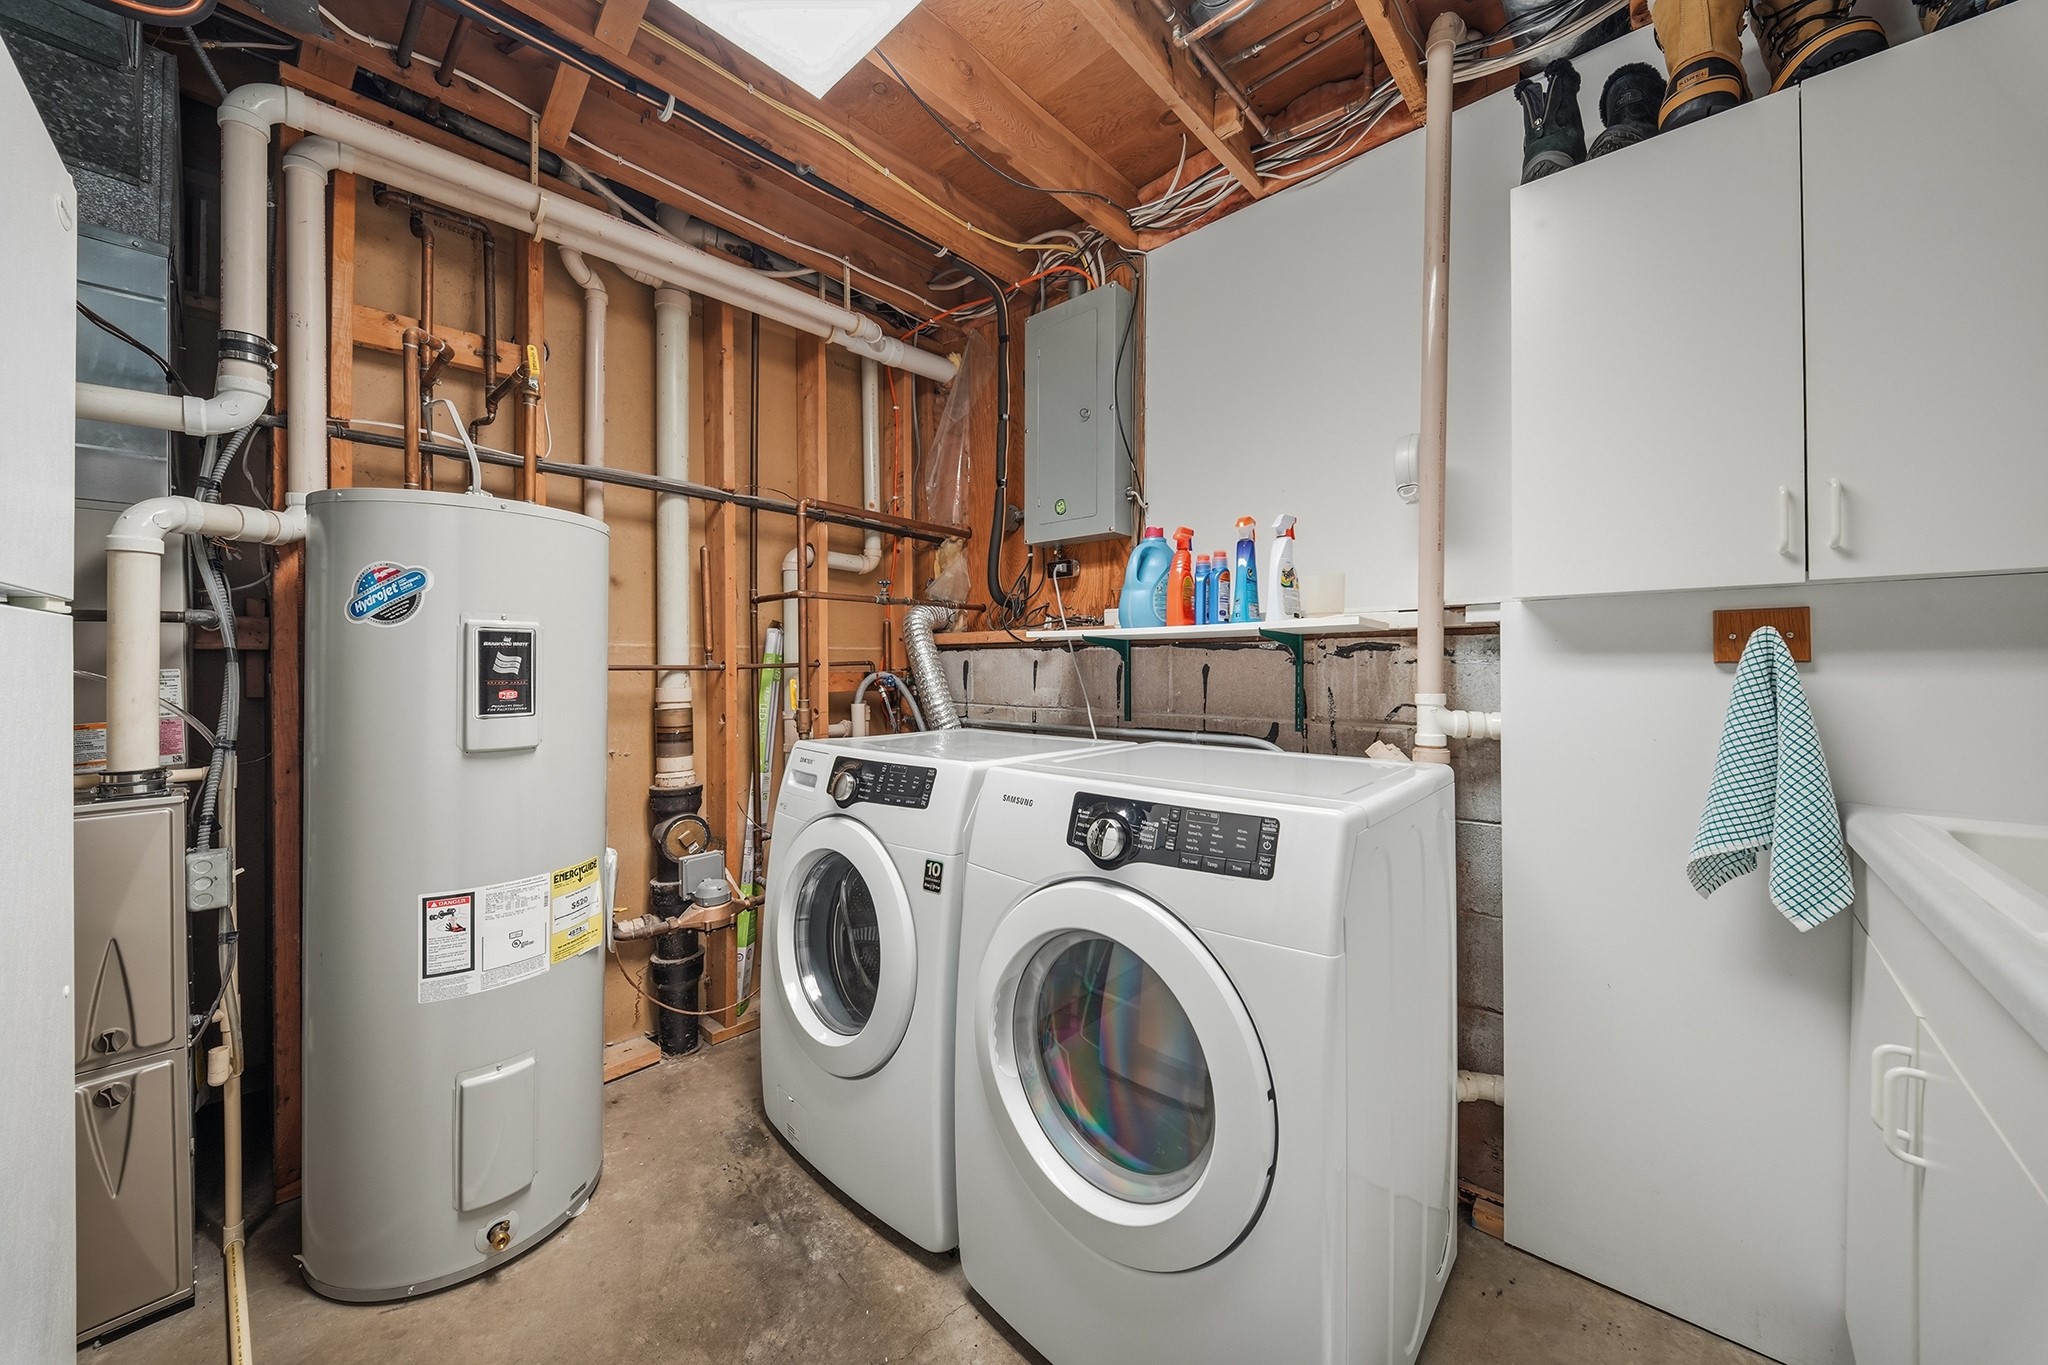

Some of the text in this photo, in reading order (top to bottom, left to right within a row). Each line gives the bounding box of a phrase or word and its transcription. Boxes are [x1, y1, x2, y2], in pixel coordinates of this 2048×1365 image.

[354, 582, 399, 613] Hydrojet
[1002, 794, 1034, 807] SAMSUNG
[926, 861, 941, 877] 10
[438, 898, 466, 907] DANGER
